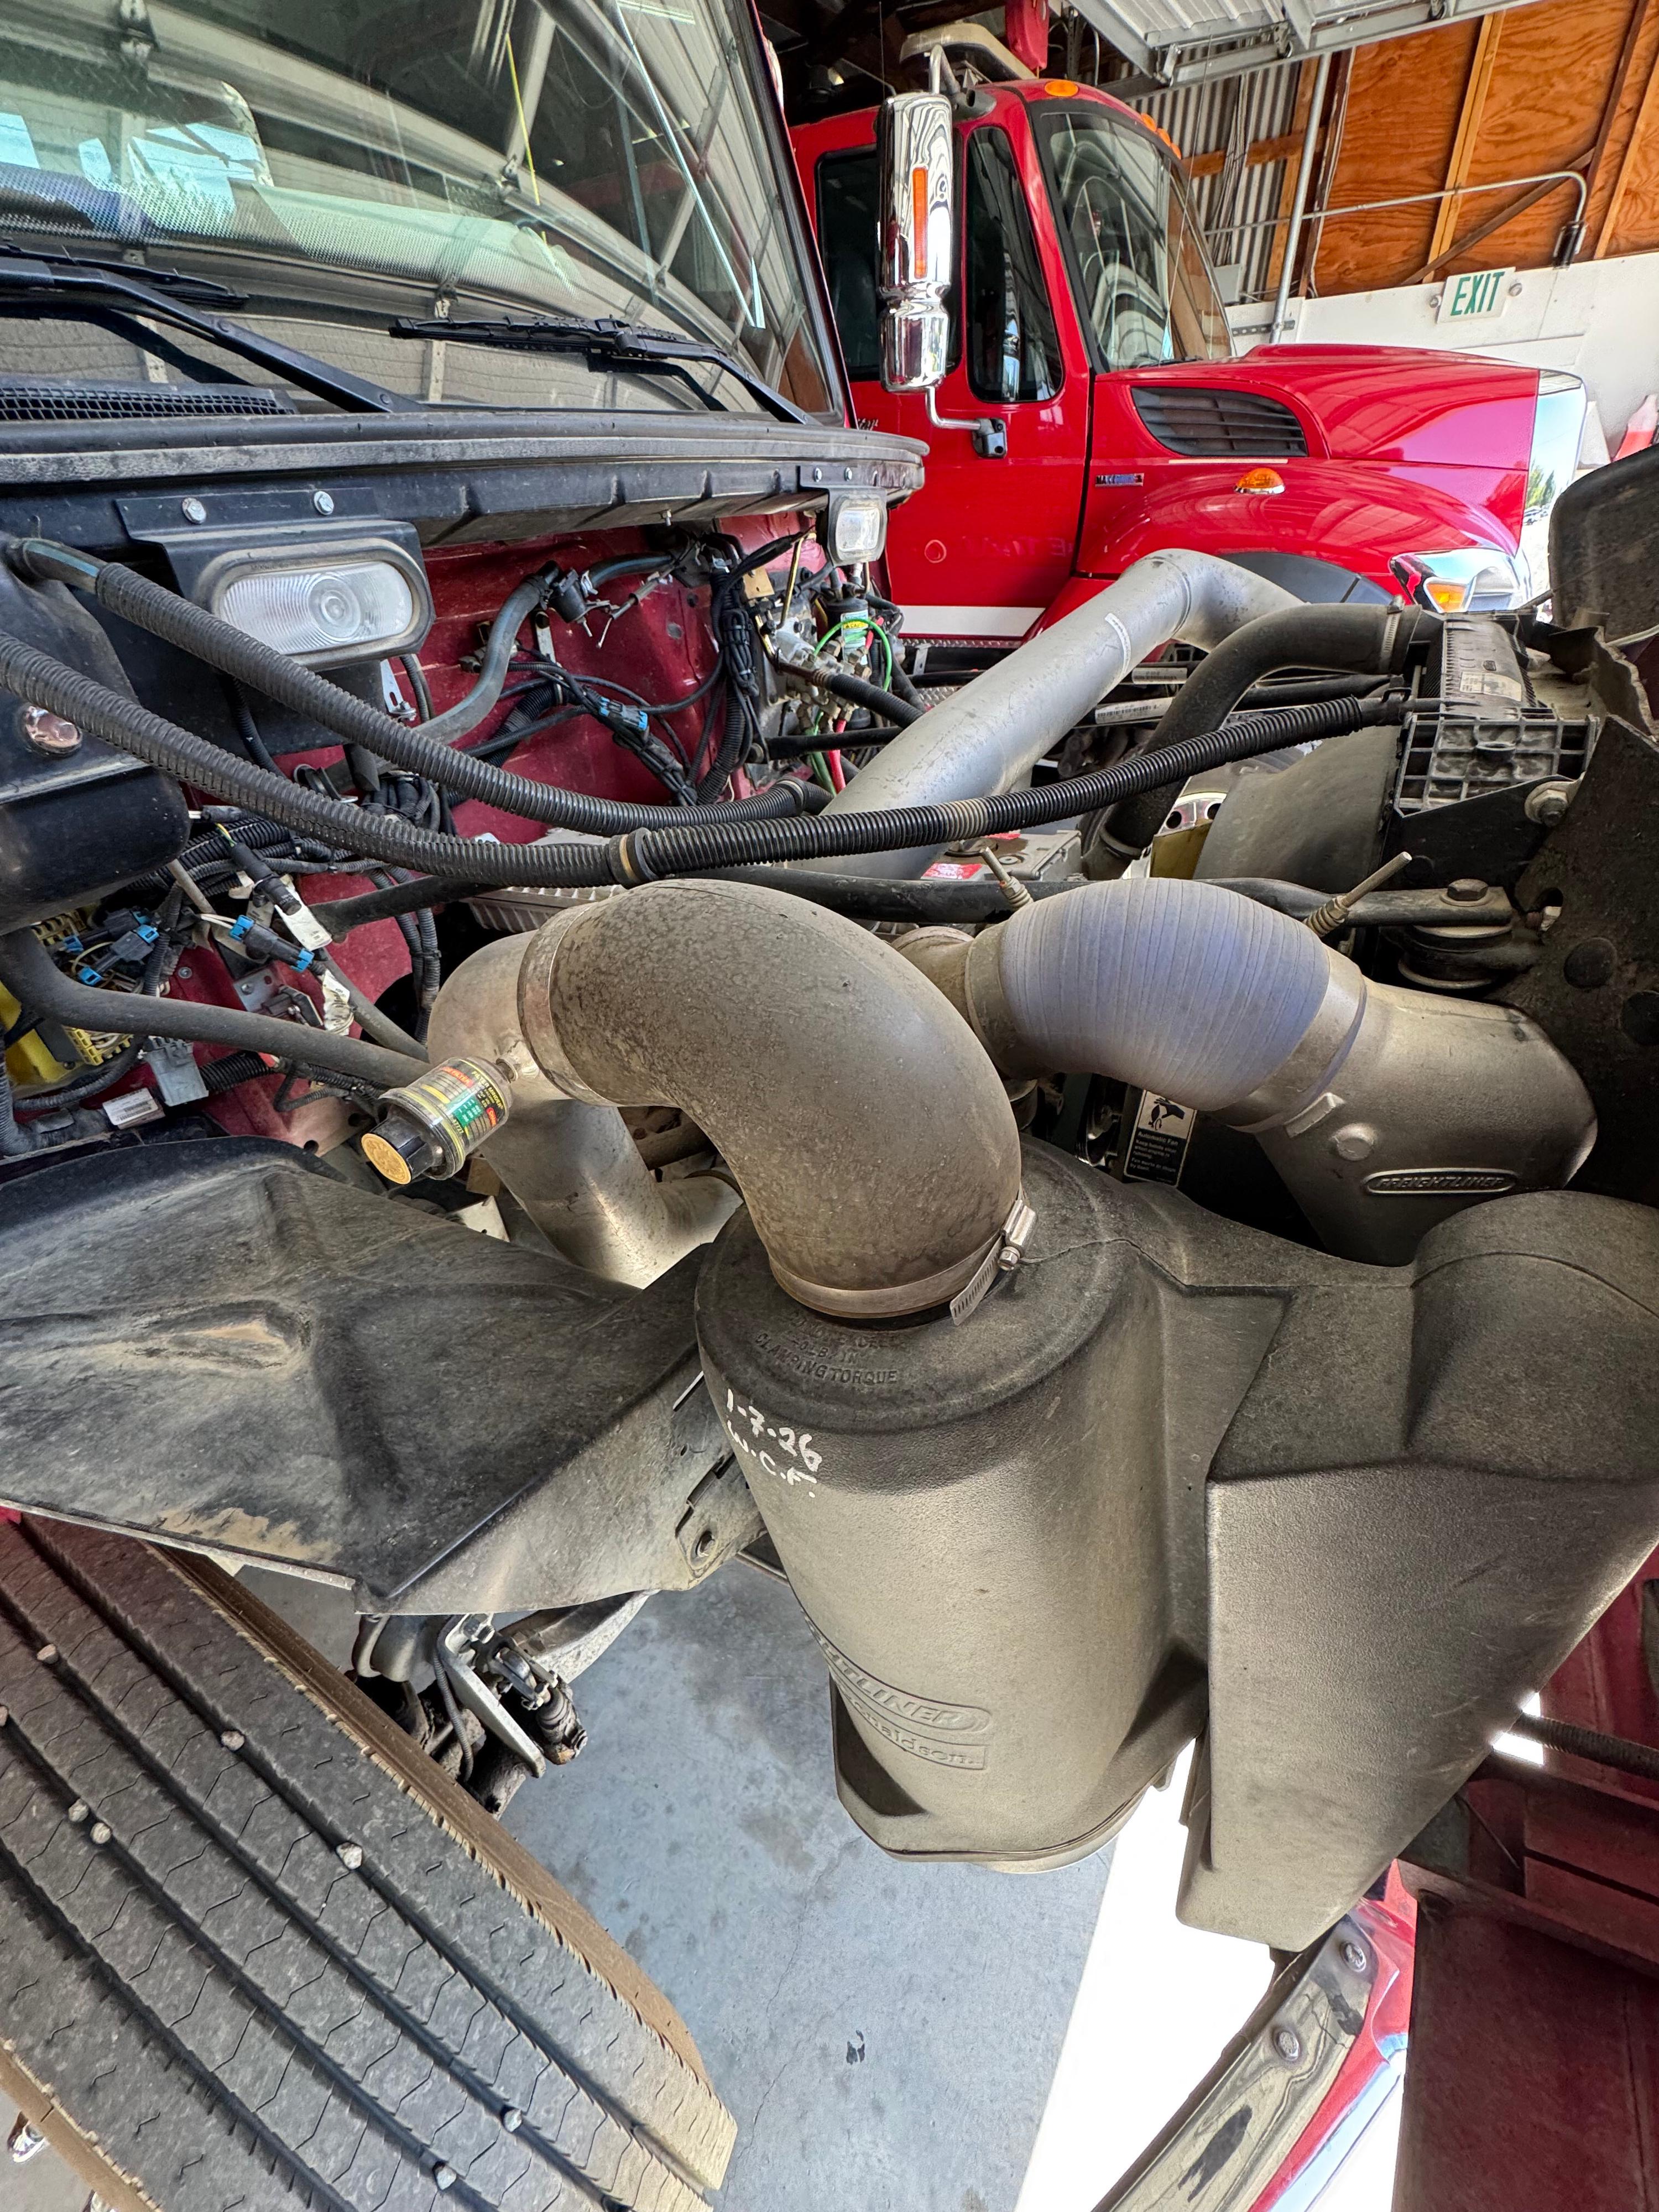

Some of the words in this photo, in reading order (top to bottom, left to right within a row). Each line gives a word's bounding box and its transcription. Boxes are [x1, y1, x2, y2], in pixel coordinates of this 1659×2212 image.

[1450, 271, 1505, 316] EXIT
[471, 1070, 489, 1088] FILTER
[1167, 1138, 1178, 1146] Fan
[1376, 1176, 1505, 1188] FREIGHTLINER
